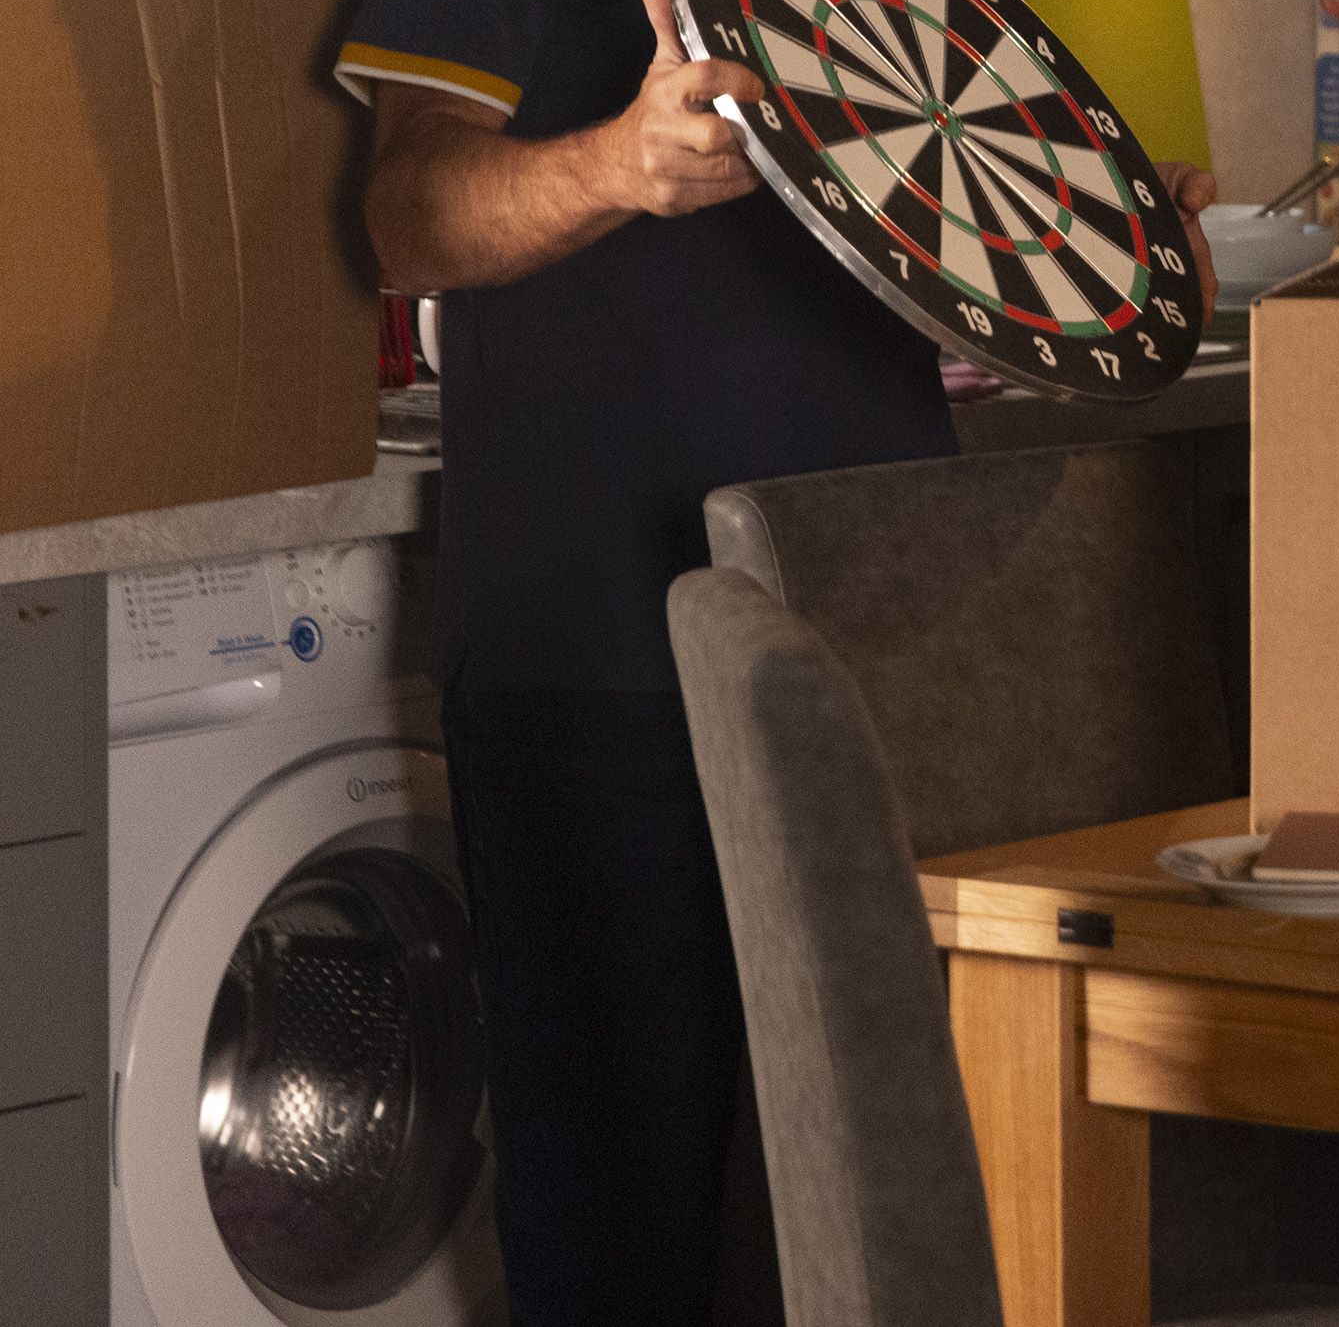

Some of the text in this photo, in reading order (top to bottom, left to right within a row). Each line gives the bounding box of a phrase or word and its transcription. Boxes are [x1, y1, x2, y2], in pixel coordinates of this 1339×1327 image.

[713, 21, 748, 57] 11
[1037, 35, 1056, 64] 4
[758, 99, 782, 131] 8
[1085, 105, 1120, 139] 13
[811, 176, 848, 212] 16
[1132, 178, 1156, 208] 6
[889, 249, 909, 281] 7
[1150, 243, 1186, 275] 10
[956, 300, 993, 336] 19
[1150, 295, 1188, 328] 15
[1032, 335, 1057, 367] 3
[1136, 331, 1162, 362] 2
[1089, 347, 1121, 381] 17
